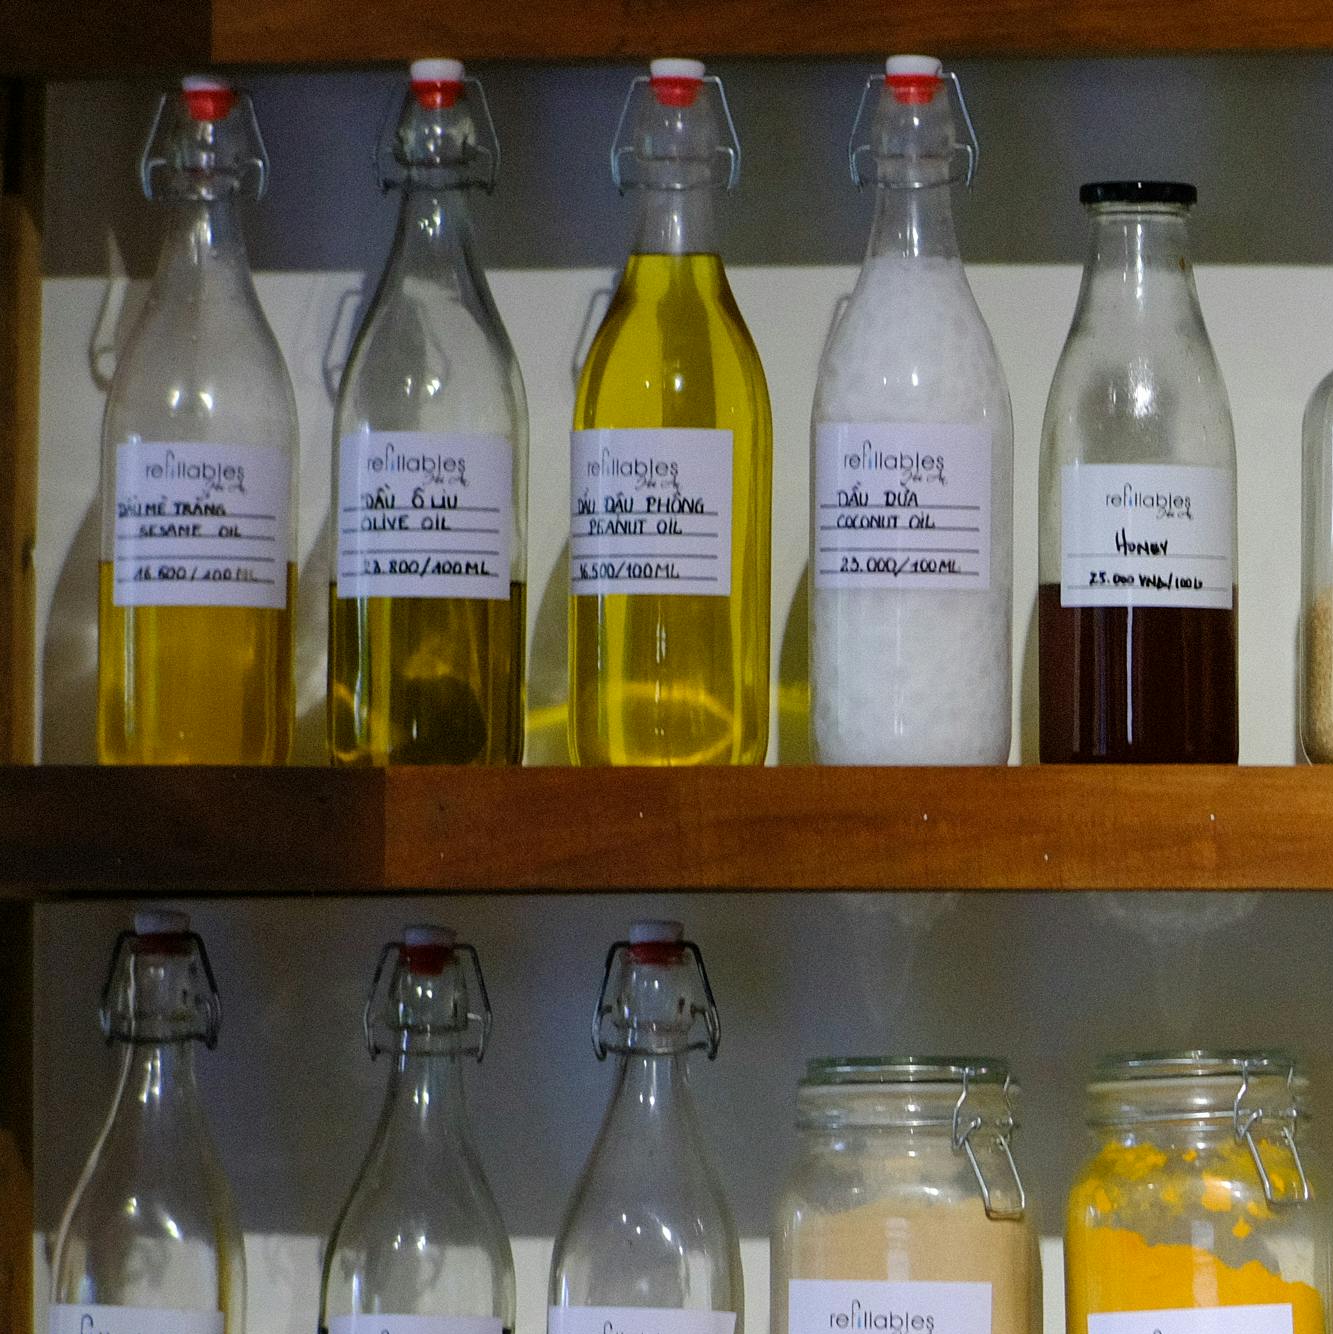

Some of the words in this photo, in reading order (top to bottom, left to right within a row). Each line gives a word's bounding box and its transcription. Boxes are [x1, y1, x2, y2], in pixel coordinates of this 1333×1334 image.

[146, 450, 244, 482] refillables
[368, 442, 465, 472] refillables
[588, 447, 678, 478] refillables
[844, 440, 944, 470] refillables
[1106, 482, 1191, 510] refillables
[590, 520, 645, 535] PEANUT
[837, 515, 900, 528] COCONUT
[830, 1299, 934, 1330] refillables
